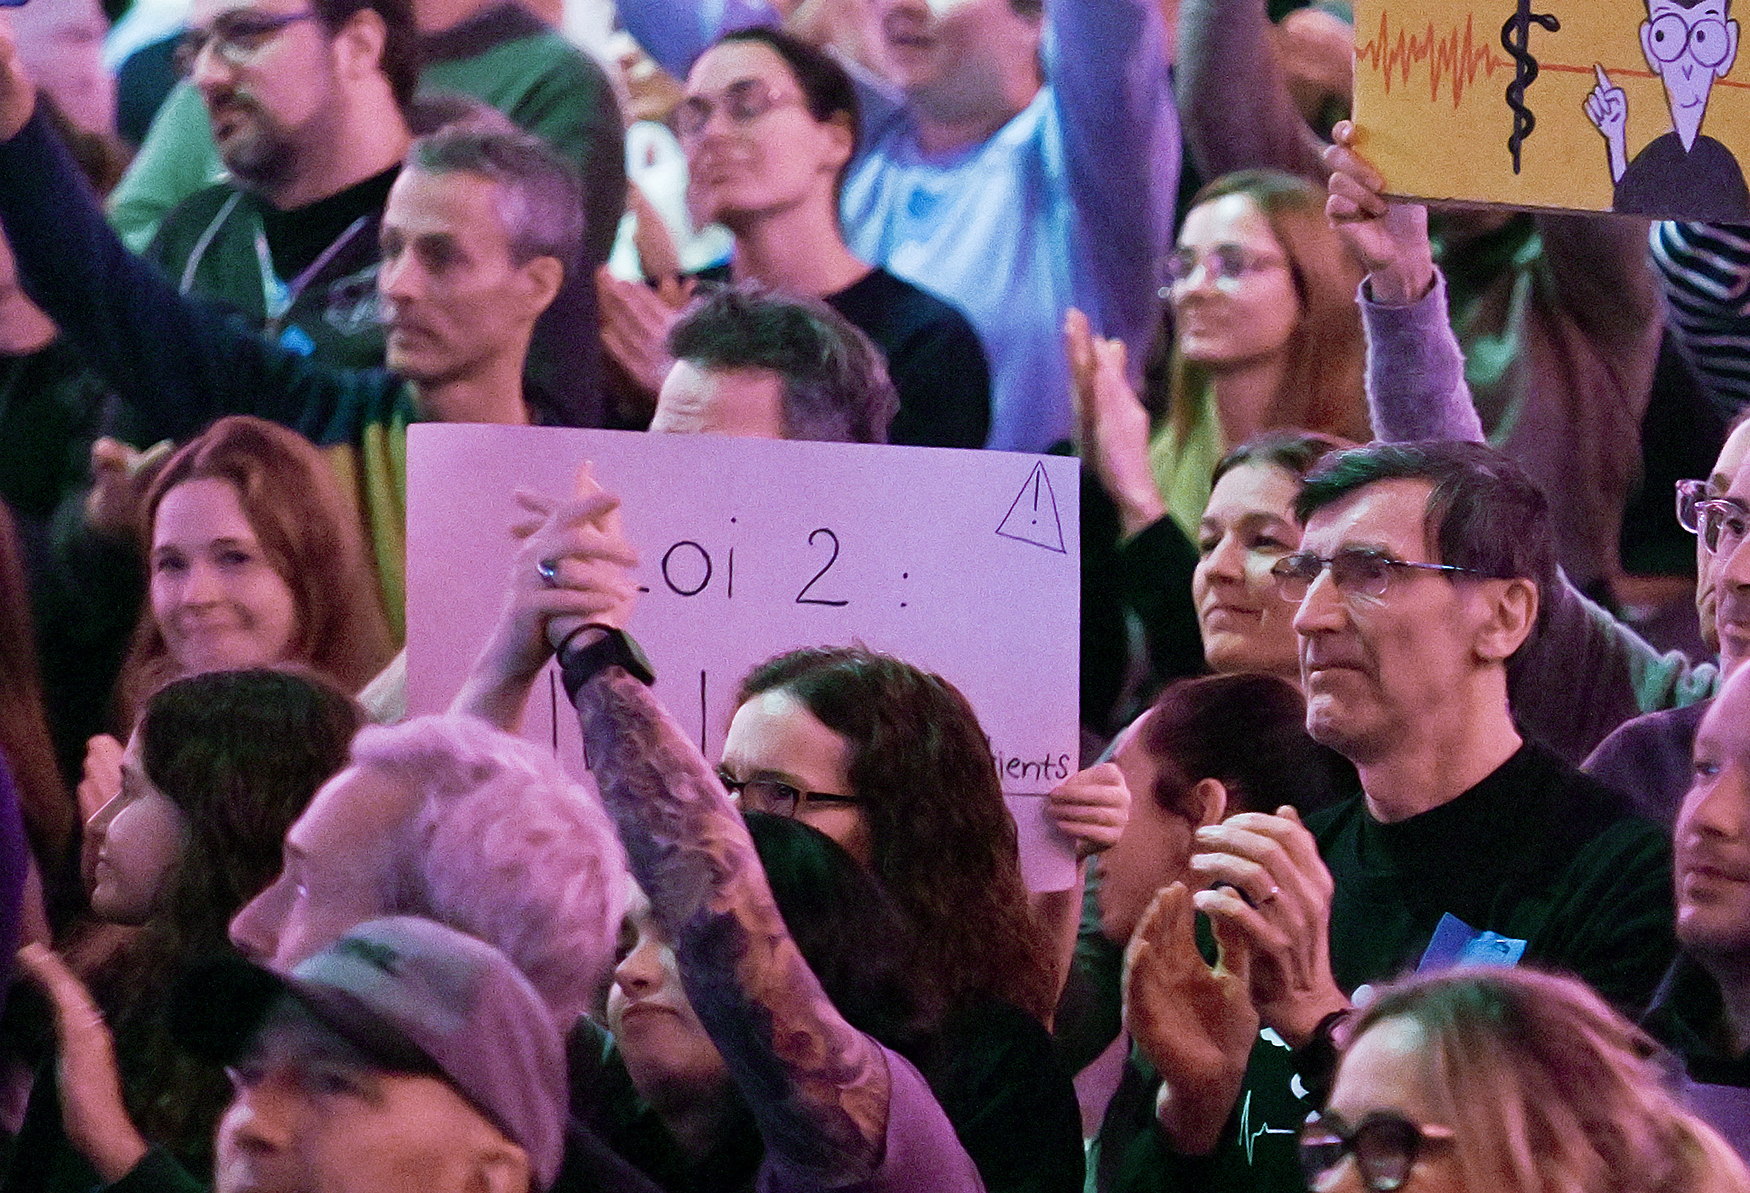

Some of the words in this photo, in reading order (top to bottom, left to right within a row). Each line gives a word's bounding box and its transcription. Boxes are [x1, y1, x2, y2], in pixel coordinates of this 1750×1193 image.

[637, 516, 738, 599] oi
[795, 527, 849, 608] 2
[986, 736, 1071, 783] ients
